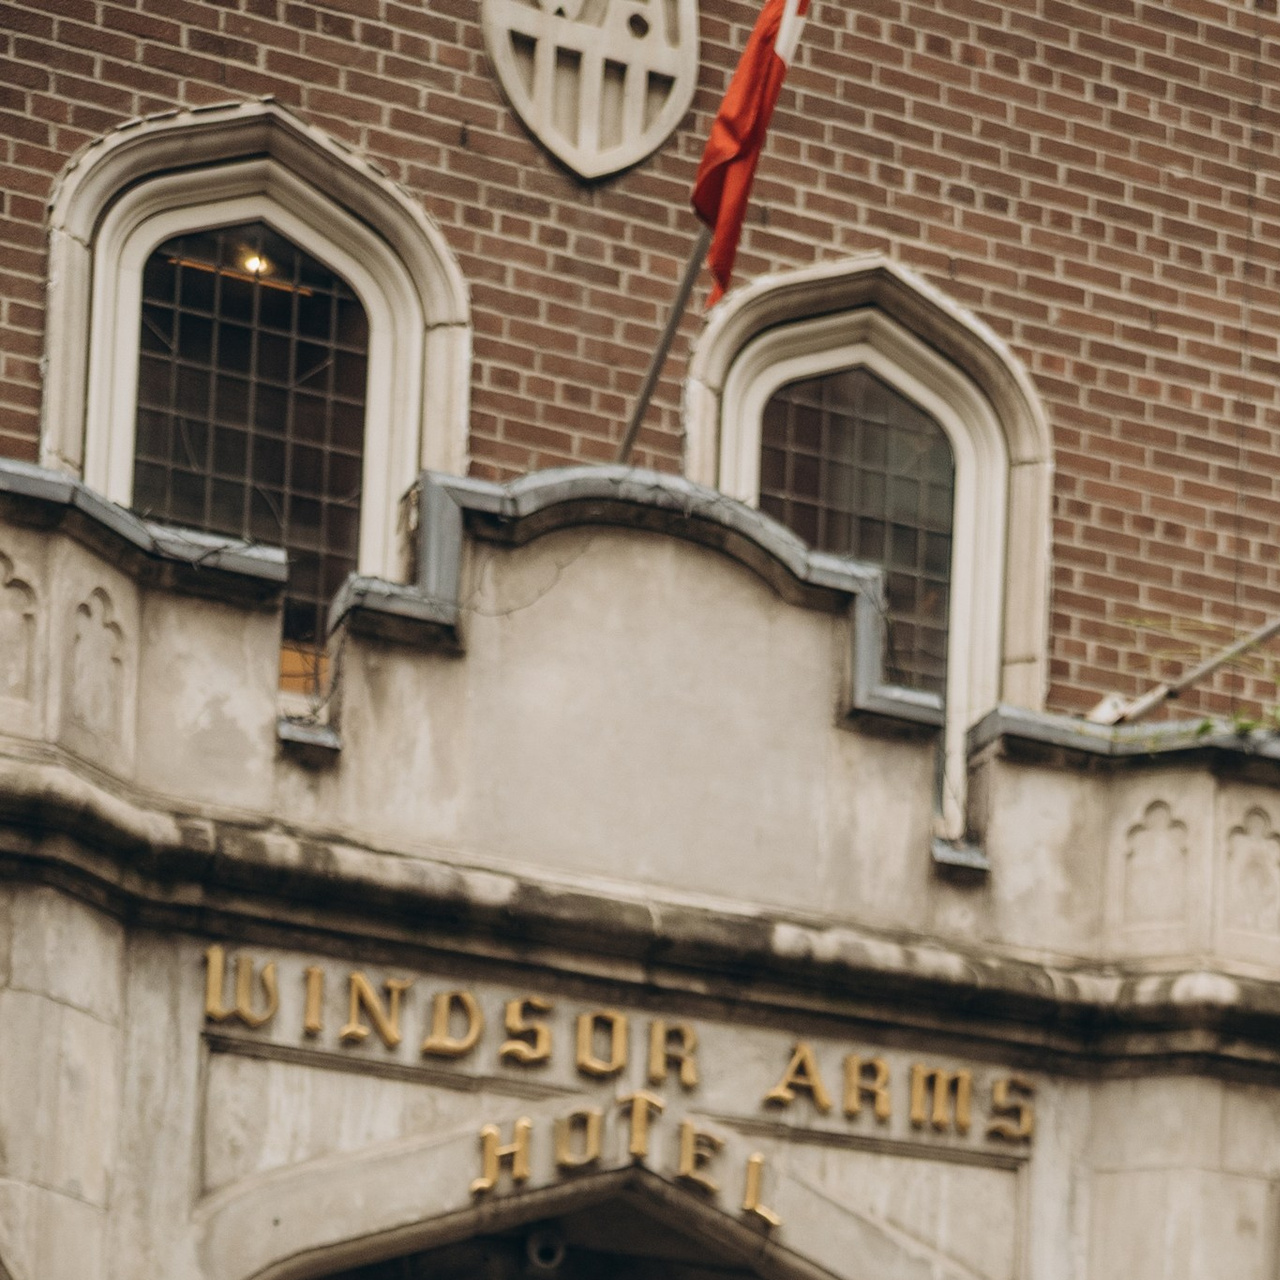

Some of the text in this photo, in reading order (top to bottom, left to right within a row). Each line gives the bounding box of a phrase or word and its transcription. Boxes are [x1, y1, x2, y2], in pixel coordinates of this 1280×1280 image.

[203, 943, 1035, 1140] WINDSOR ARMS
[469, 1088, 783, 1227] HOTEL
